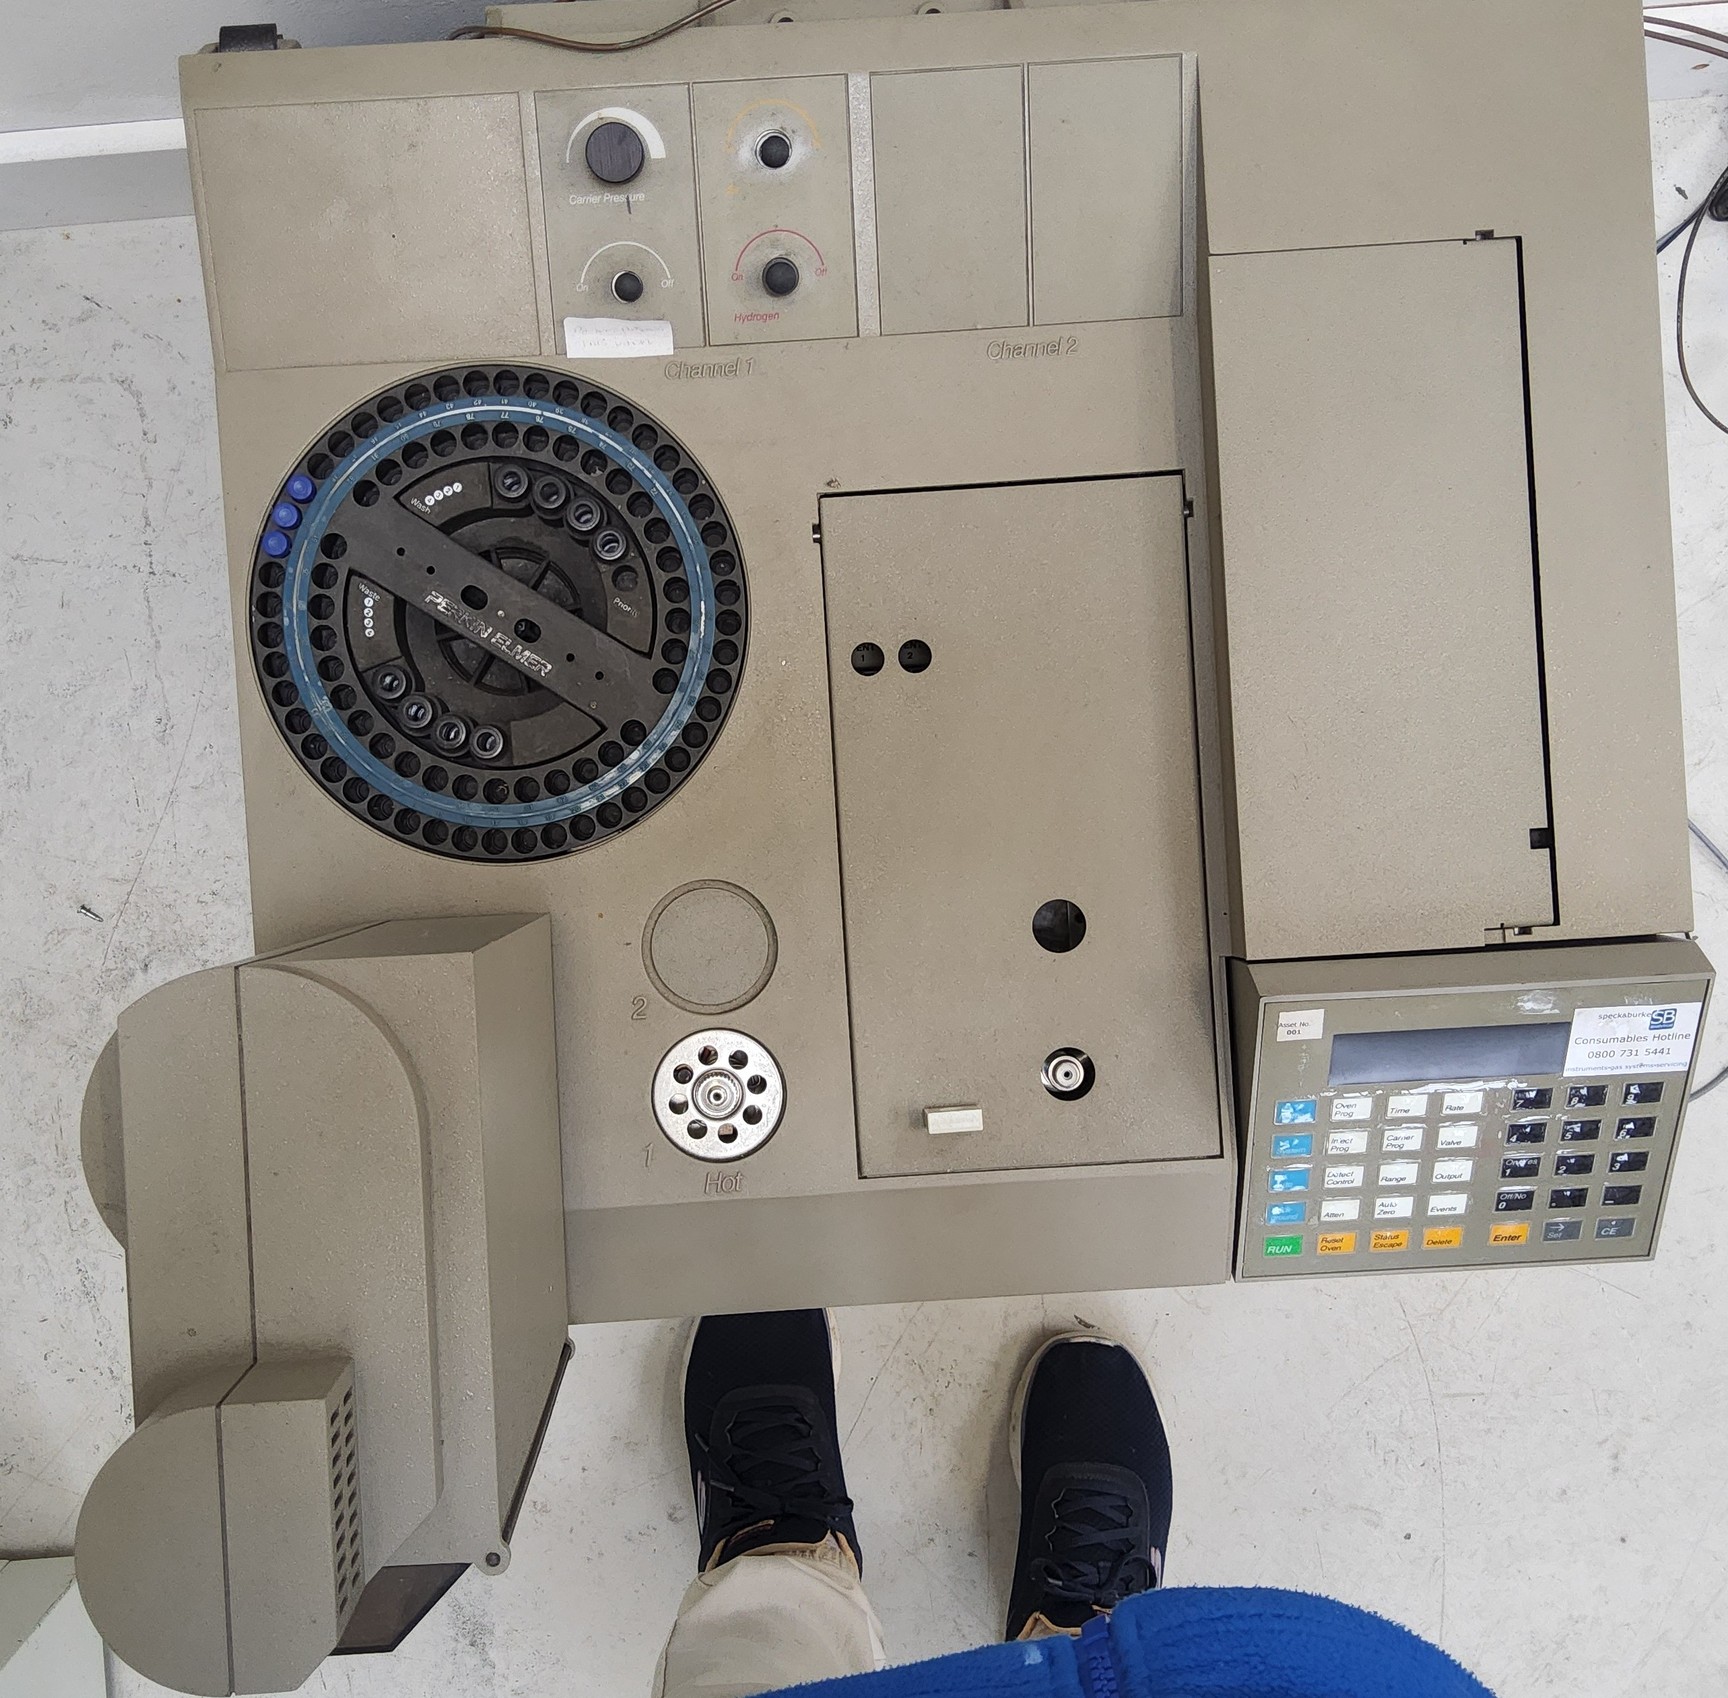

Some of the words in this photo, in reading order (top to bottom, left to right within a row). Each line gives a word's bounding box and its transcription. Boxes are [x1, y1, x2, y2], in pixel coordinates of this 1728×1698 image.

[569, 194, 601, 204] Carrier
[731, 273, 744, 282] On
[814, 268, 828, 277] Off
[576, 283, 588, 292] On
[661, 278, 674, 288] Off
[734, 312, 780, 324] Hydrogen
[986, 336, 1063, 360] Channel
[1066, 336, 1078, 356] 2
[664, 357, 740, 380] Channel
[745, 356, 754, 376] 1
[410, 497, 431, 514] Wash
[358, 582, 380, 602] Waste
[424, 590, 493, 638] PERKIN
[490, 632, 553, 677] ELMER
[631, 996, 648, 1020] 2
[1650, 1010, 1676, 1024] SB
[1574, 1034, 1648, 1045] Consumables
[1652, 1032, 1691, 1042] Hotline
[1588, 1050, 1615, 1059] 0800
[1620, 1049, 1639, 1058] 731
[1644, 1048, 1671, 1056] 5441
[643, 1142, 653, 1168] 1
[704, 1172, 744, 1194] Hot
[1493, 1234, 1522, 1242] Enter
